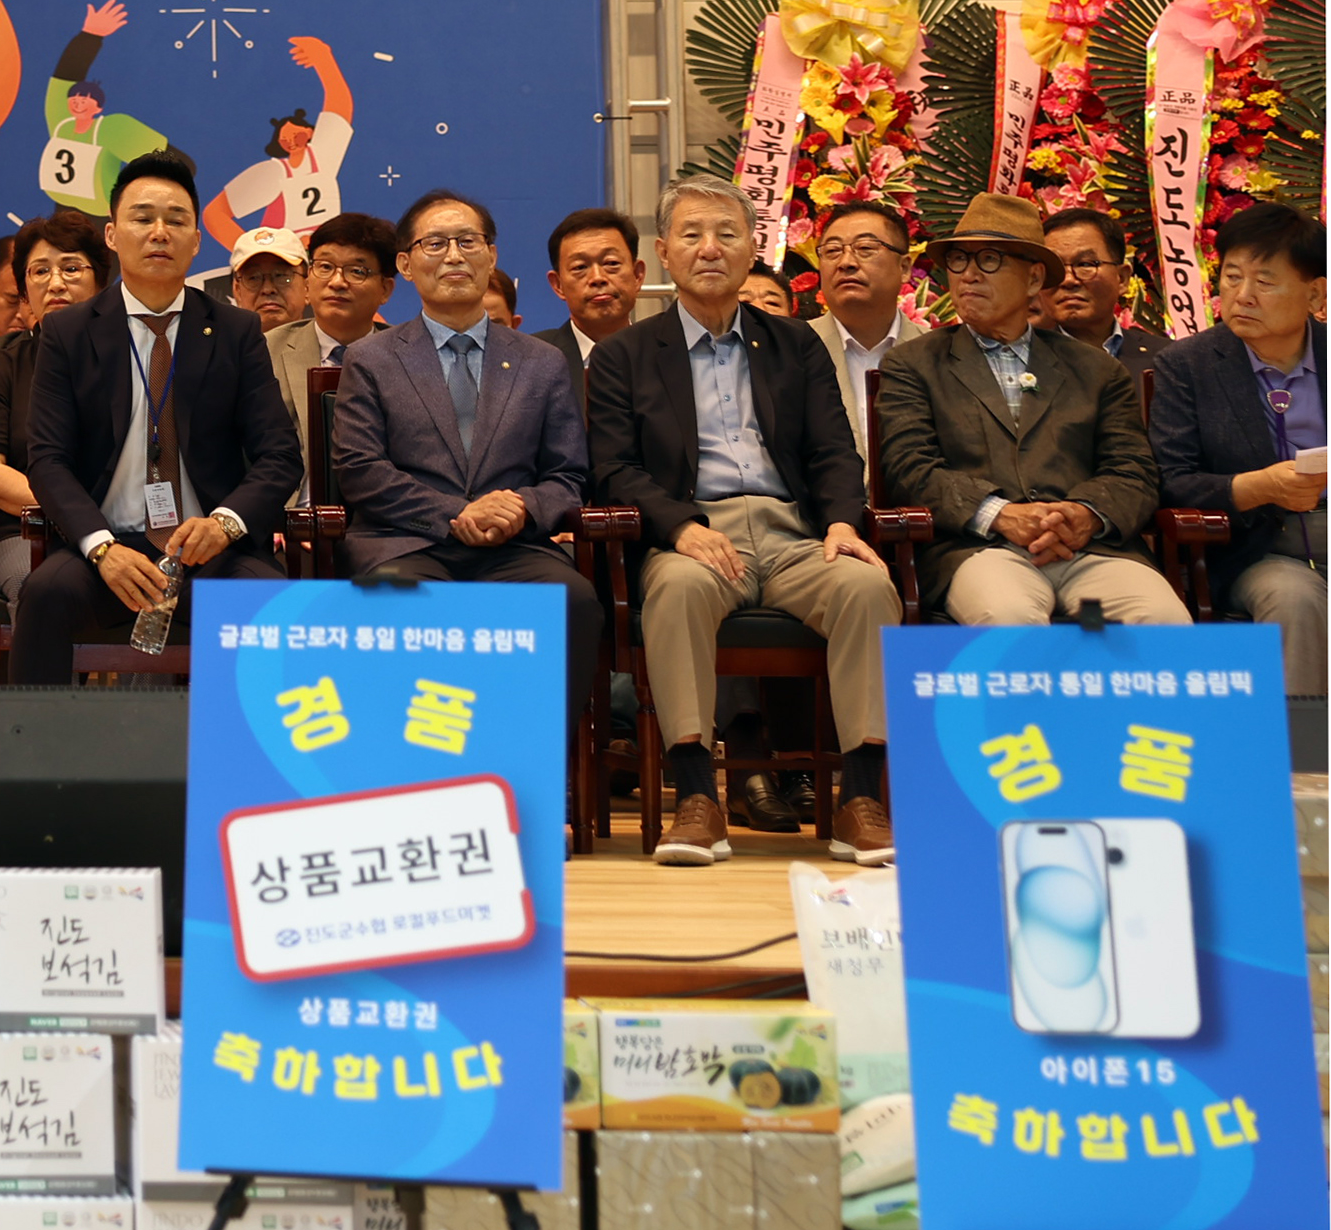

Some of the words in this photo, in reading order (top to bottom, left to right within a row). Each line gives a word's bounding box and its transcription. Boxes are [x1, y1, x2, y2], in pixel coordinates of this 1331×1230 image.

[54, 148, 76, 185] 3
[303, 187, 325, 217] 2
[218, 624, 280, 650] 글로벌
[286, 625, 349, 650] 근로자
[354, 626, 397, 652] 통일
[402, 627, 466, 653] 한마음
[471, 628, 536, 654] 올림픽
[912, 671, 981, 698] 글로벌
[985, 671, 1054, 697] 근로자
[1058, 671, 1105, 697] 통일
[1109, 671, 1179, 697] 한마음
[1184, 671, 1254, 697] 올림픽
[249, 827, 495, 904] 상품교환권
[40, 915, 91, 946] 진도
[41, 947, 124, 986] 보석김
[298, 996, 439, 1031] 상품교환권
[212, 1030, 504, 1101] 축하합니다
[0, 1110, 82, 1148] 보석김
[947, 1092, 1260, 1161] 축하합니다
